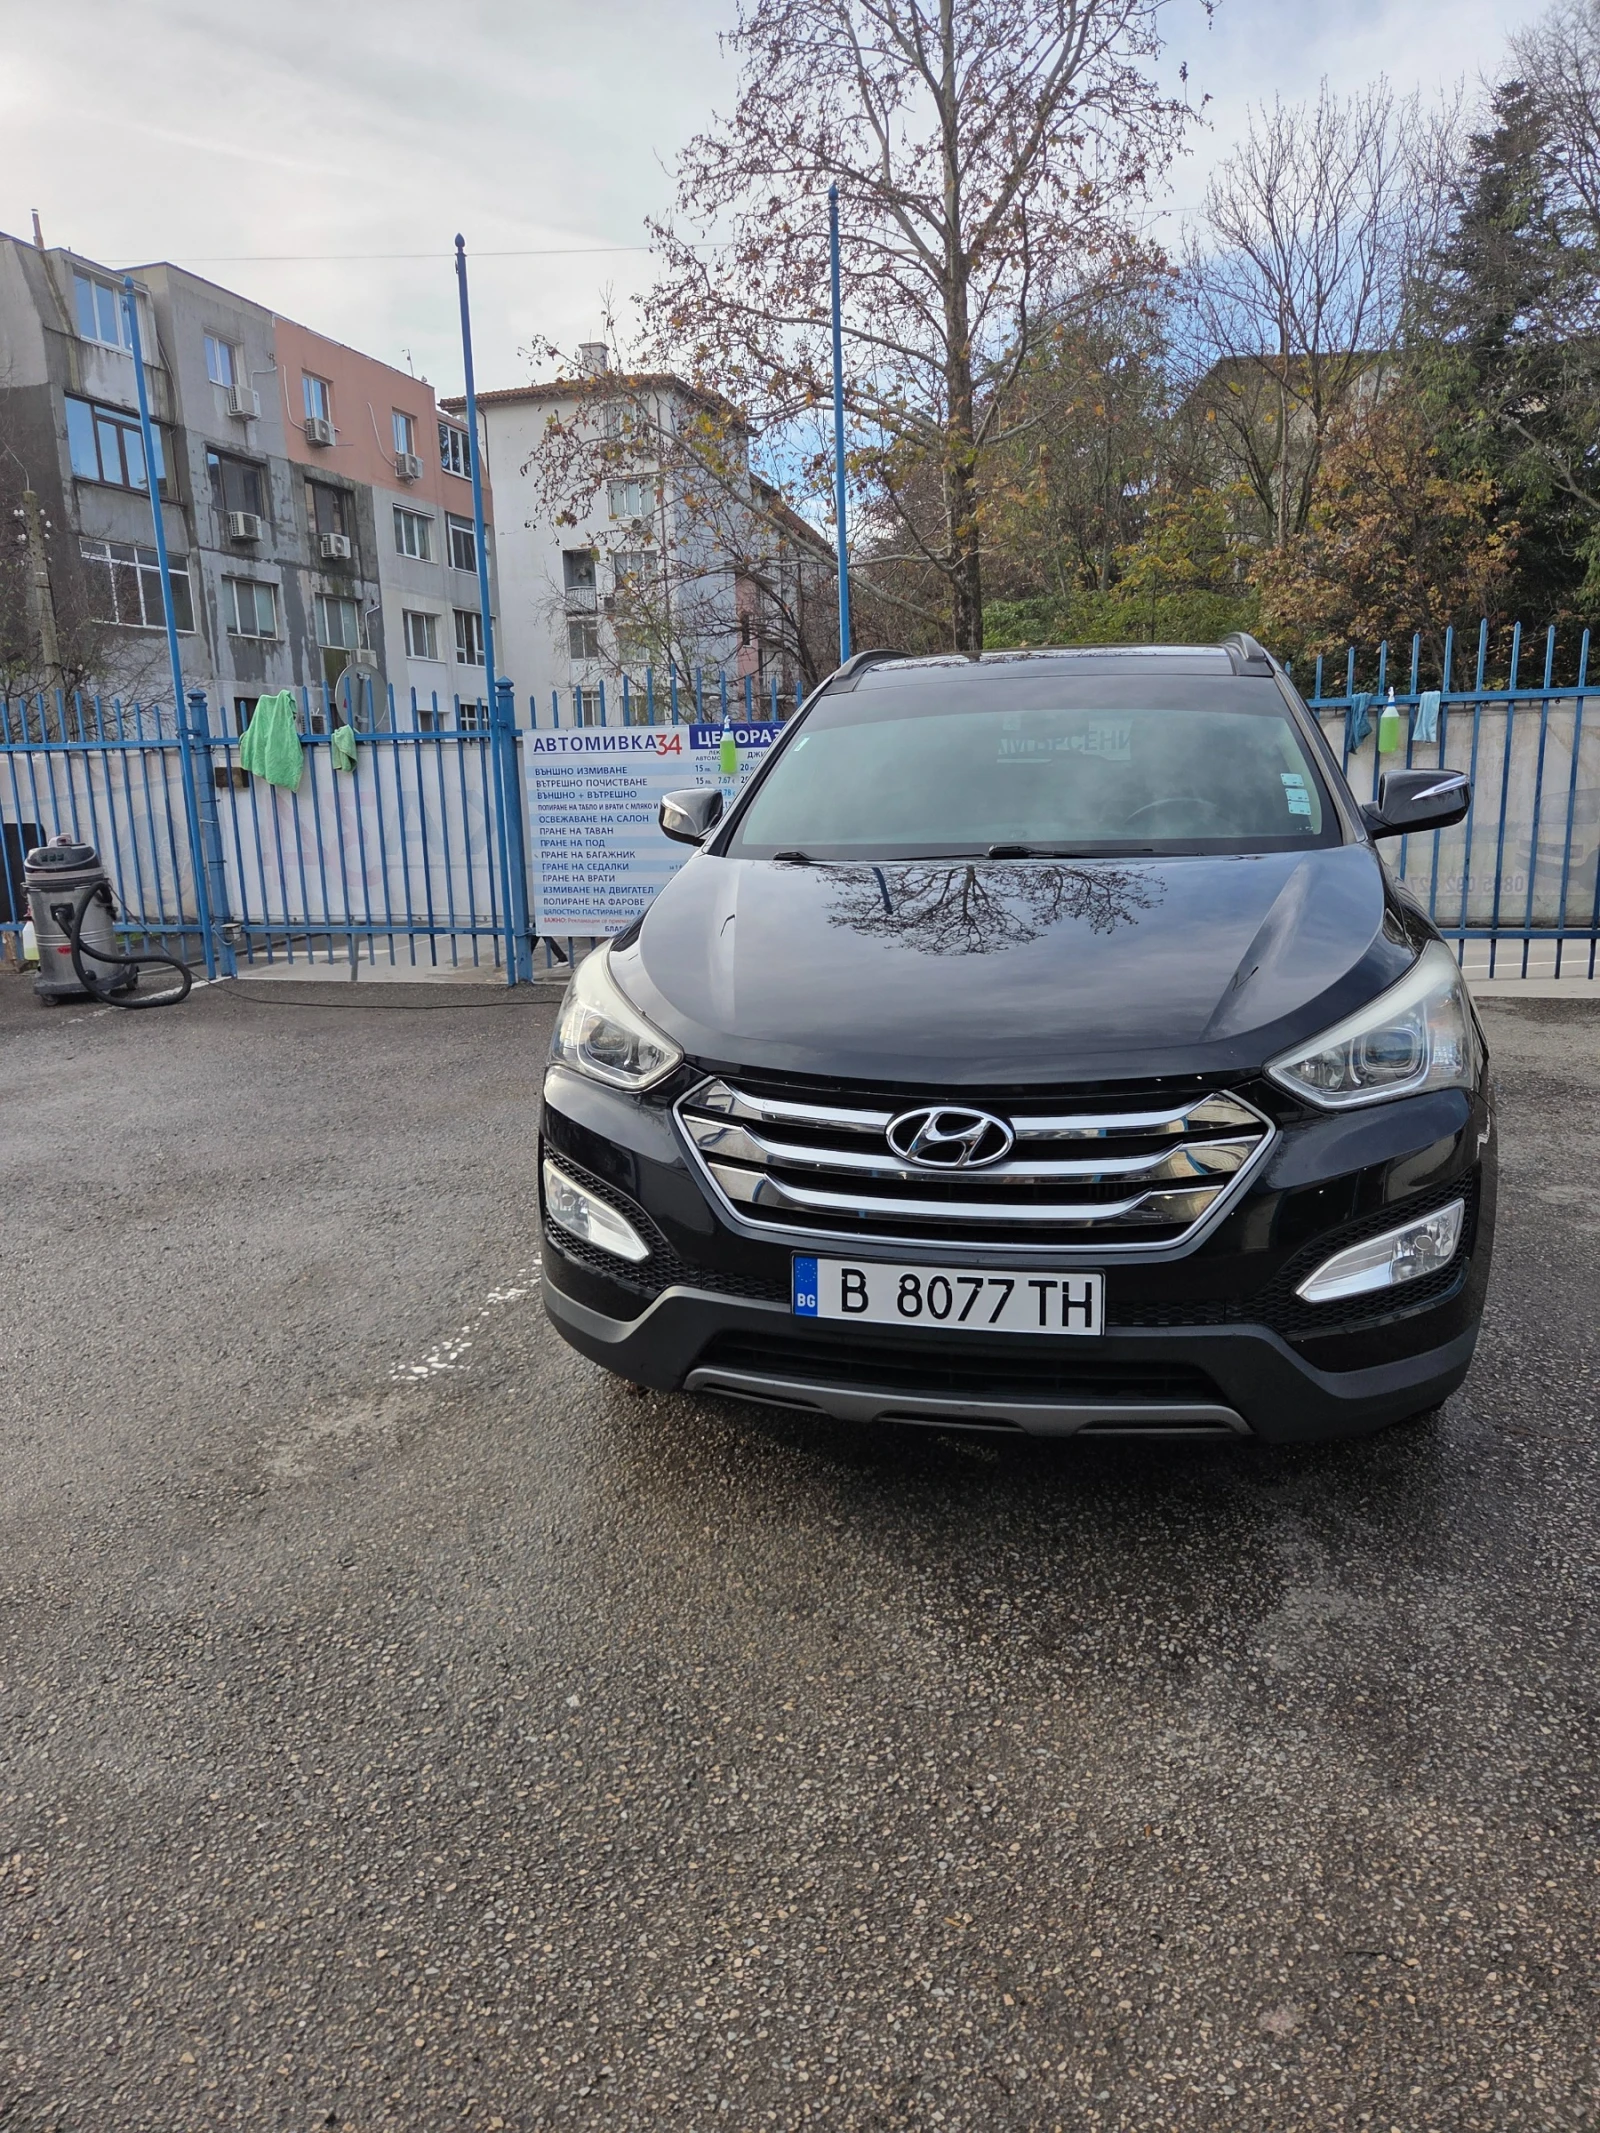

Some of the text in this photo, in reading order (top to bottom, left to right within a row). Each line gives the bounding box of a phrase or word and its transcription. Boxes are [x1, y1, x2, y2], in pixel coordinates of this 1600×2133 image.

[535, 766, 628, 776] ВЪНШНО ИЗМИВАНЕ
[536, 778, 648, 788] ВЪТРЕШНО ПОЧИСТВАНЕ
[696, 777, 704, 785] 15
[537, 791, 576, 800] ВЪНШНО
[587, 790, 637, 799] ВЪТРЕШНО
[569, 803, 577, 811] НА
[539, 814, 649, 824] ОСВЕЖАВАНЕ НА САЛОН
[540, 827, 614, 836] ПРАНЕ НА ТАВАН
[540, 839, 606, 848] ПРАНЕ НА ПОД
[541, 851, 636, 859] ПРАНЕ НА БАГАЖНИК
[572, 863, 584, 871] НА
[587, 863, 629, 872] СЕДАЛКИ
[588, 874, 615, 882] ВРАТИ
[543, 886, 654, 895] ИЗМИВАНЕ НА ДВИГАТЕЛ
[543, 898, 645, 906] ПОЛИРАНЕ НА ФАРОВЕ
[797, 1293, 816, 1308] BG
[841, 1268, 1093, 1328] B 8077 TH
